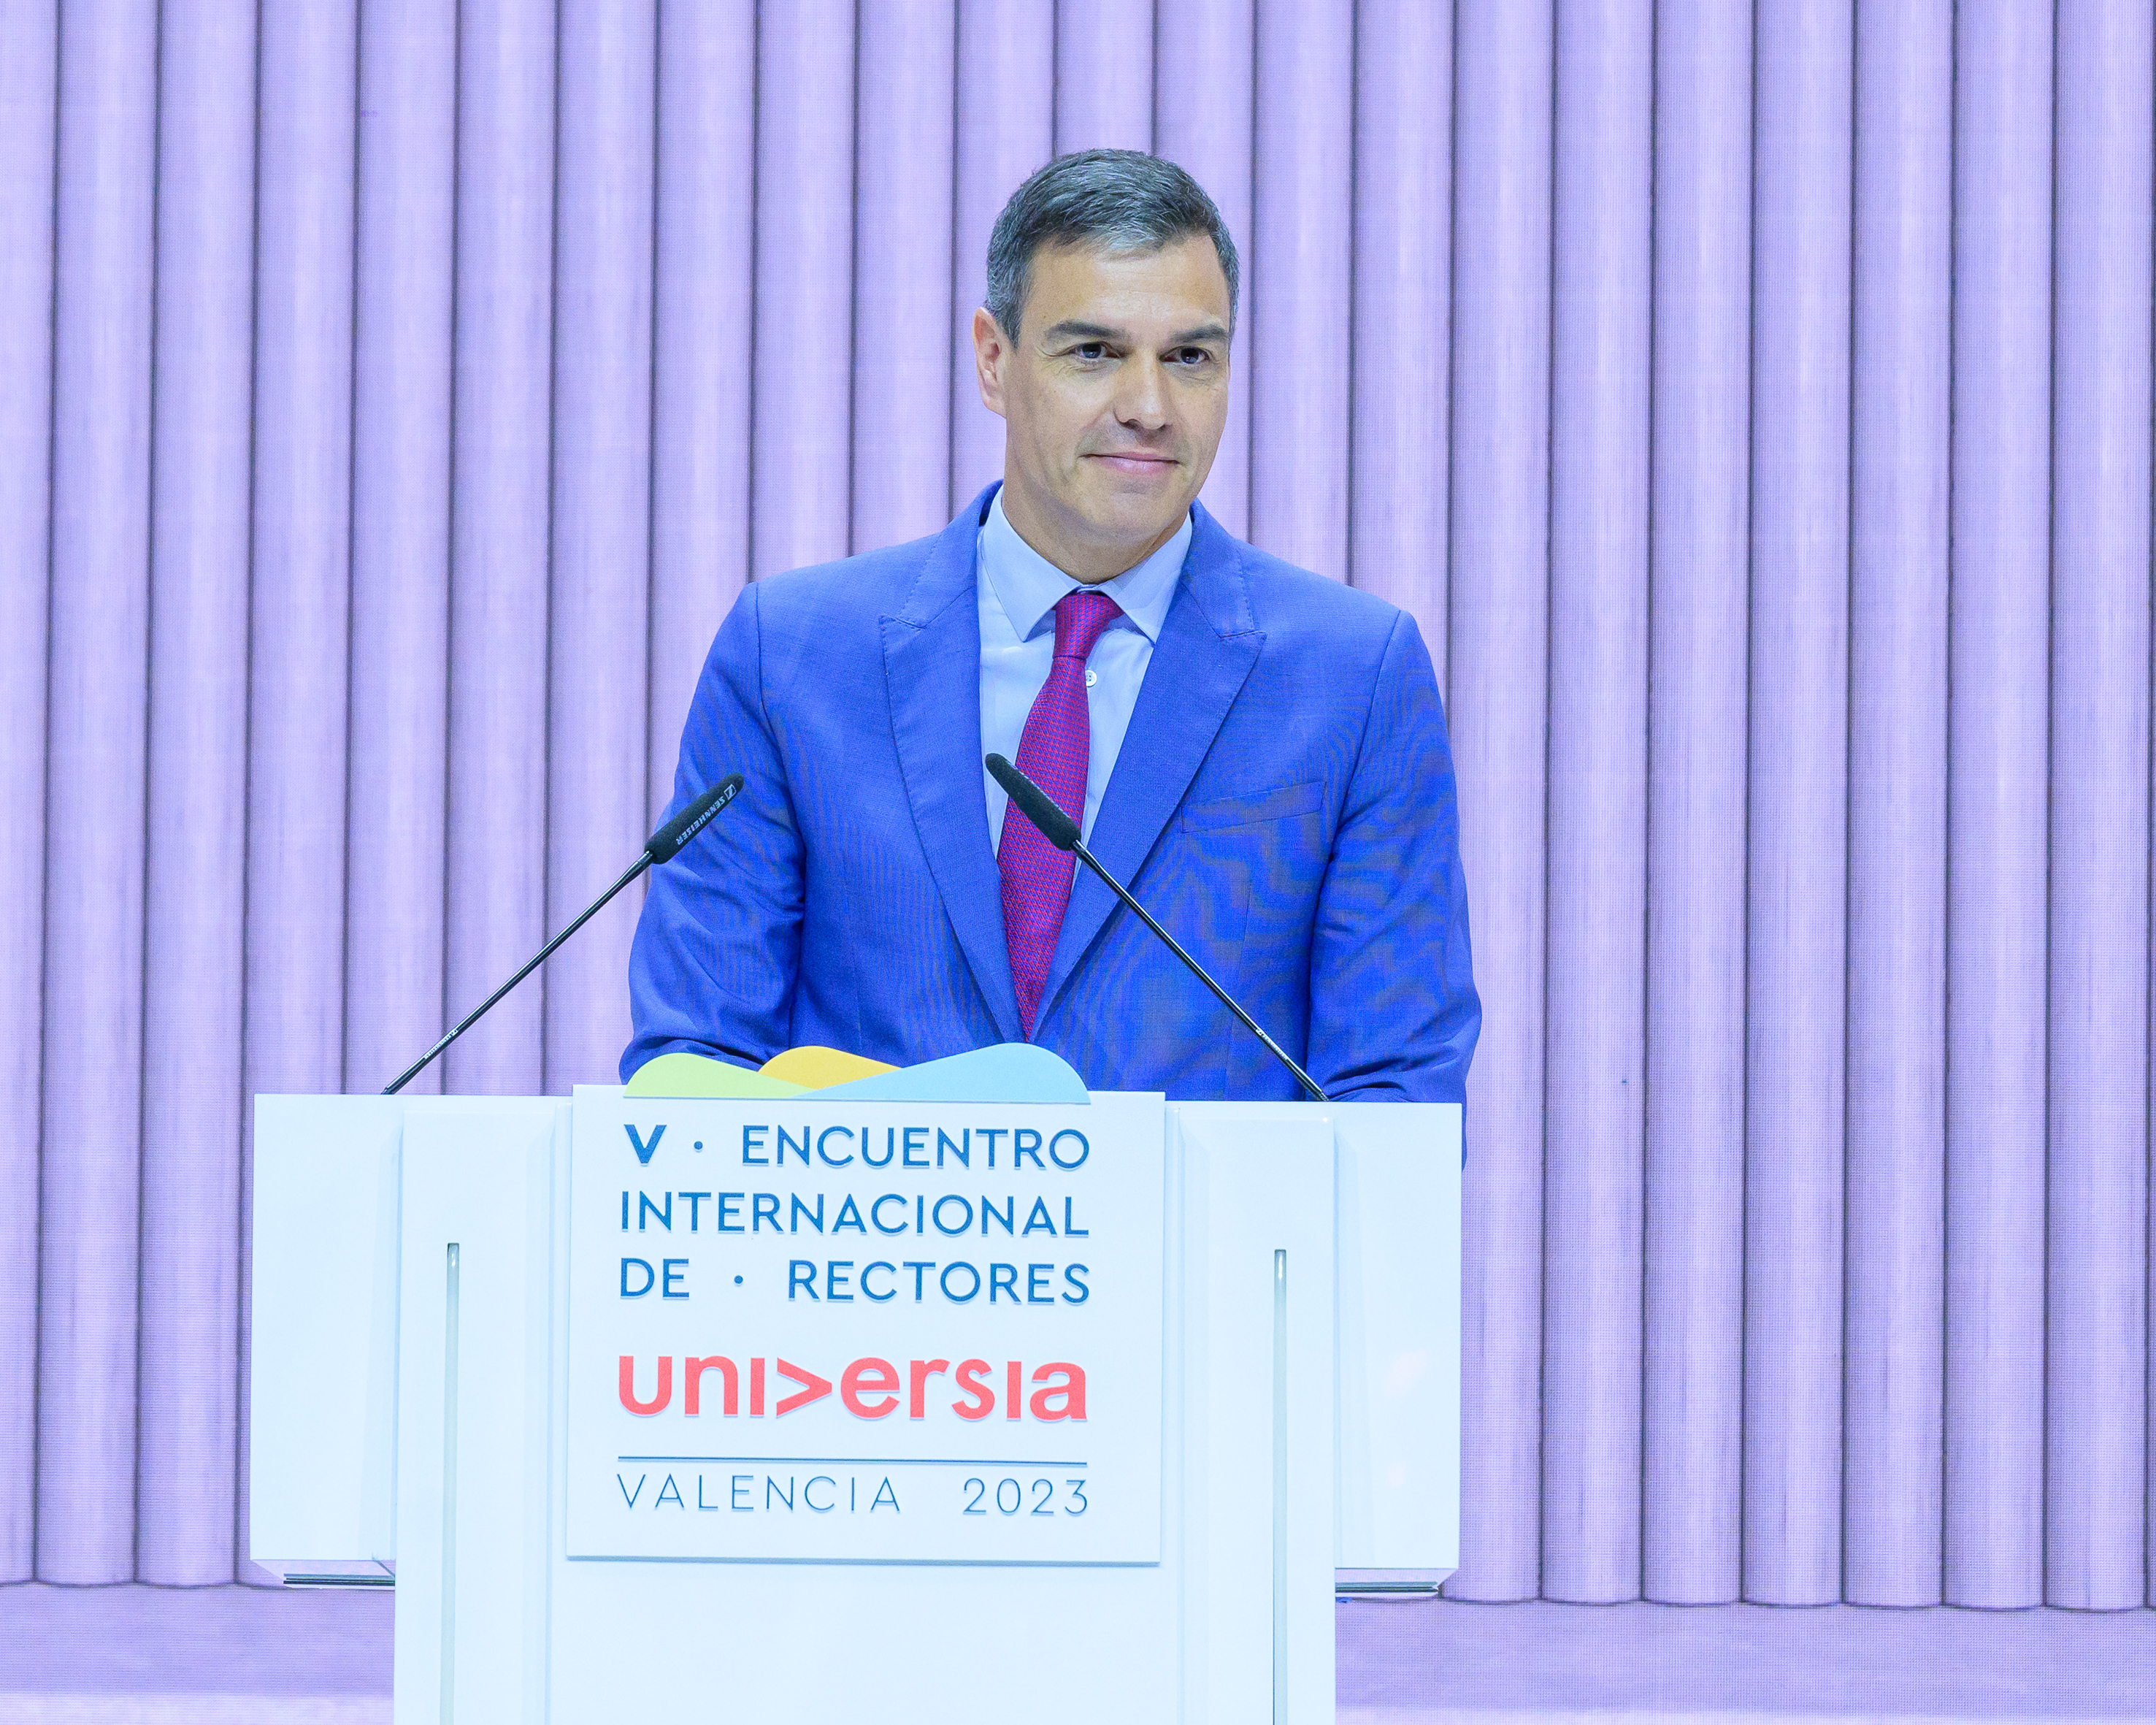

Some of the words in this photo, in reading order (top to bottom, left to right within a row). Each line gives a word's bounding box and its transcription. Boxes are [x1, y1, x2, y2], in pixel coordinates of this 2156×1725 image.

[676, 795, 726, 846] SENNHEISER
[623, 1123, 667, 1164] V
[742, 1124, 1090, 1169] ENCUENTRO
[621, 1190, 1090, 1236] INTERNACIONAL
[620, 1258, 690, 1298] DE
[788, 1259, 1090, 1304] RECTORES
[617, 1473, 901, 1512] VALENCIA
[963, 1477, 1088, 1515] 2023
